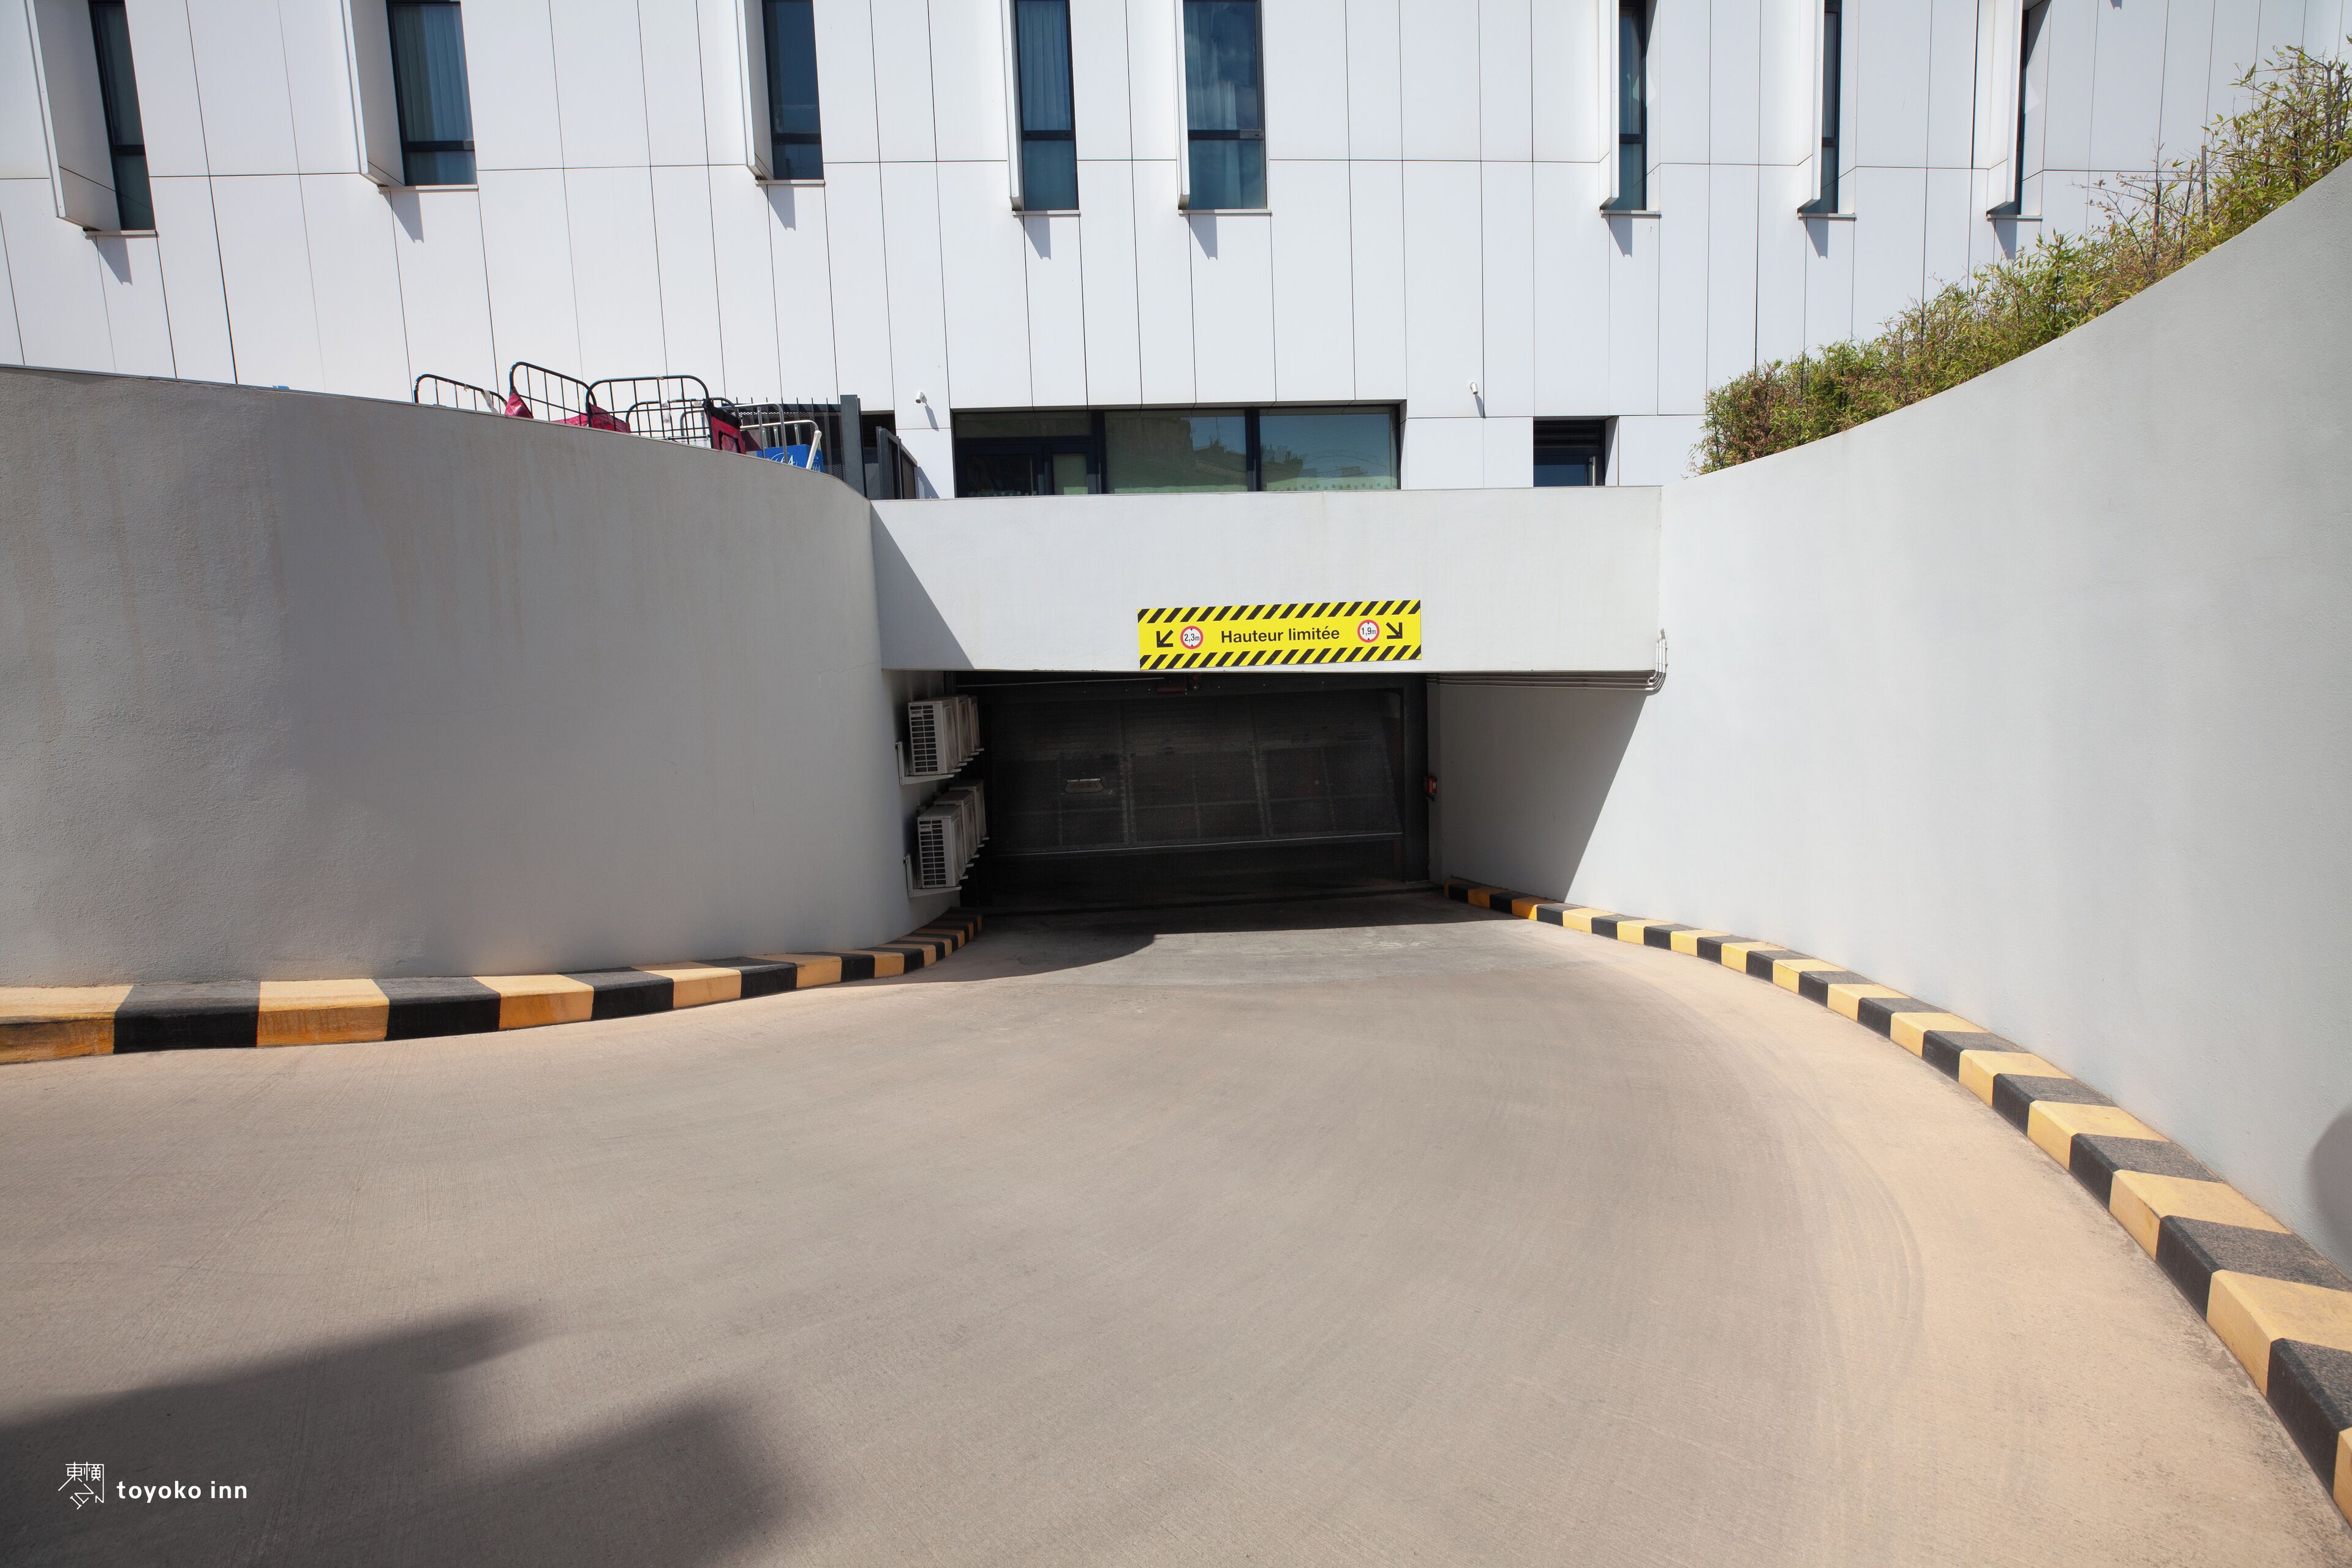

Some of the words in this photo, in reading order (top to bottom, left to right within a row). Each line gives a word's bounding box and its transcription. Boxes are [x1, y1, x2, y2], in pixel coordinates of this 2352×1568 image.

[1221, 630, 1284, 643] Hauteur
[1289, 625, 1340, 641] limitée
[1361, 627, 1376, 636] 1,9m
[1184, 633, 1200, 643] 2,3m
